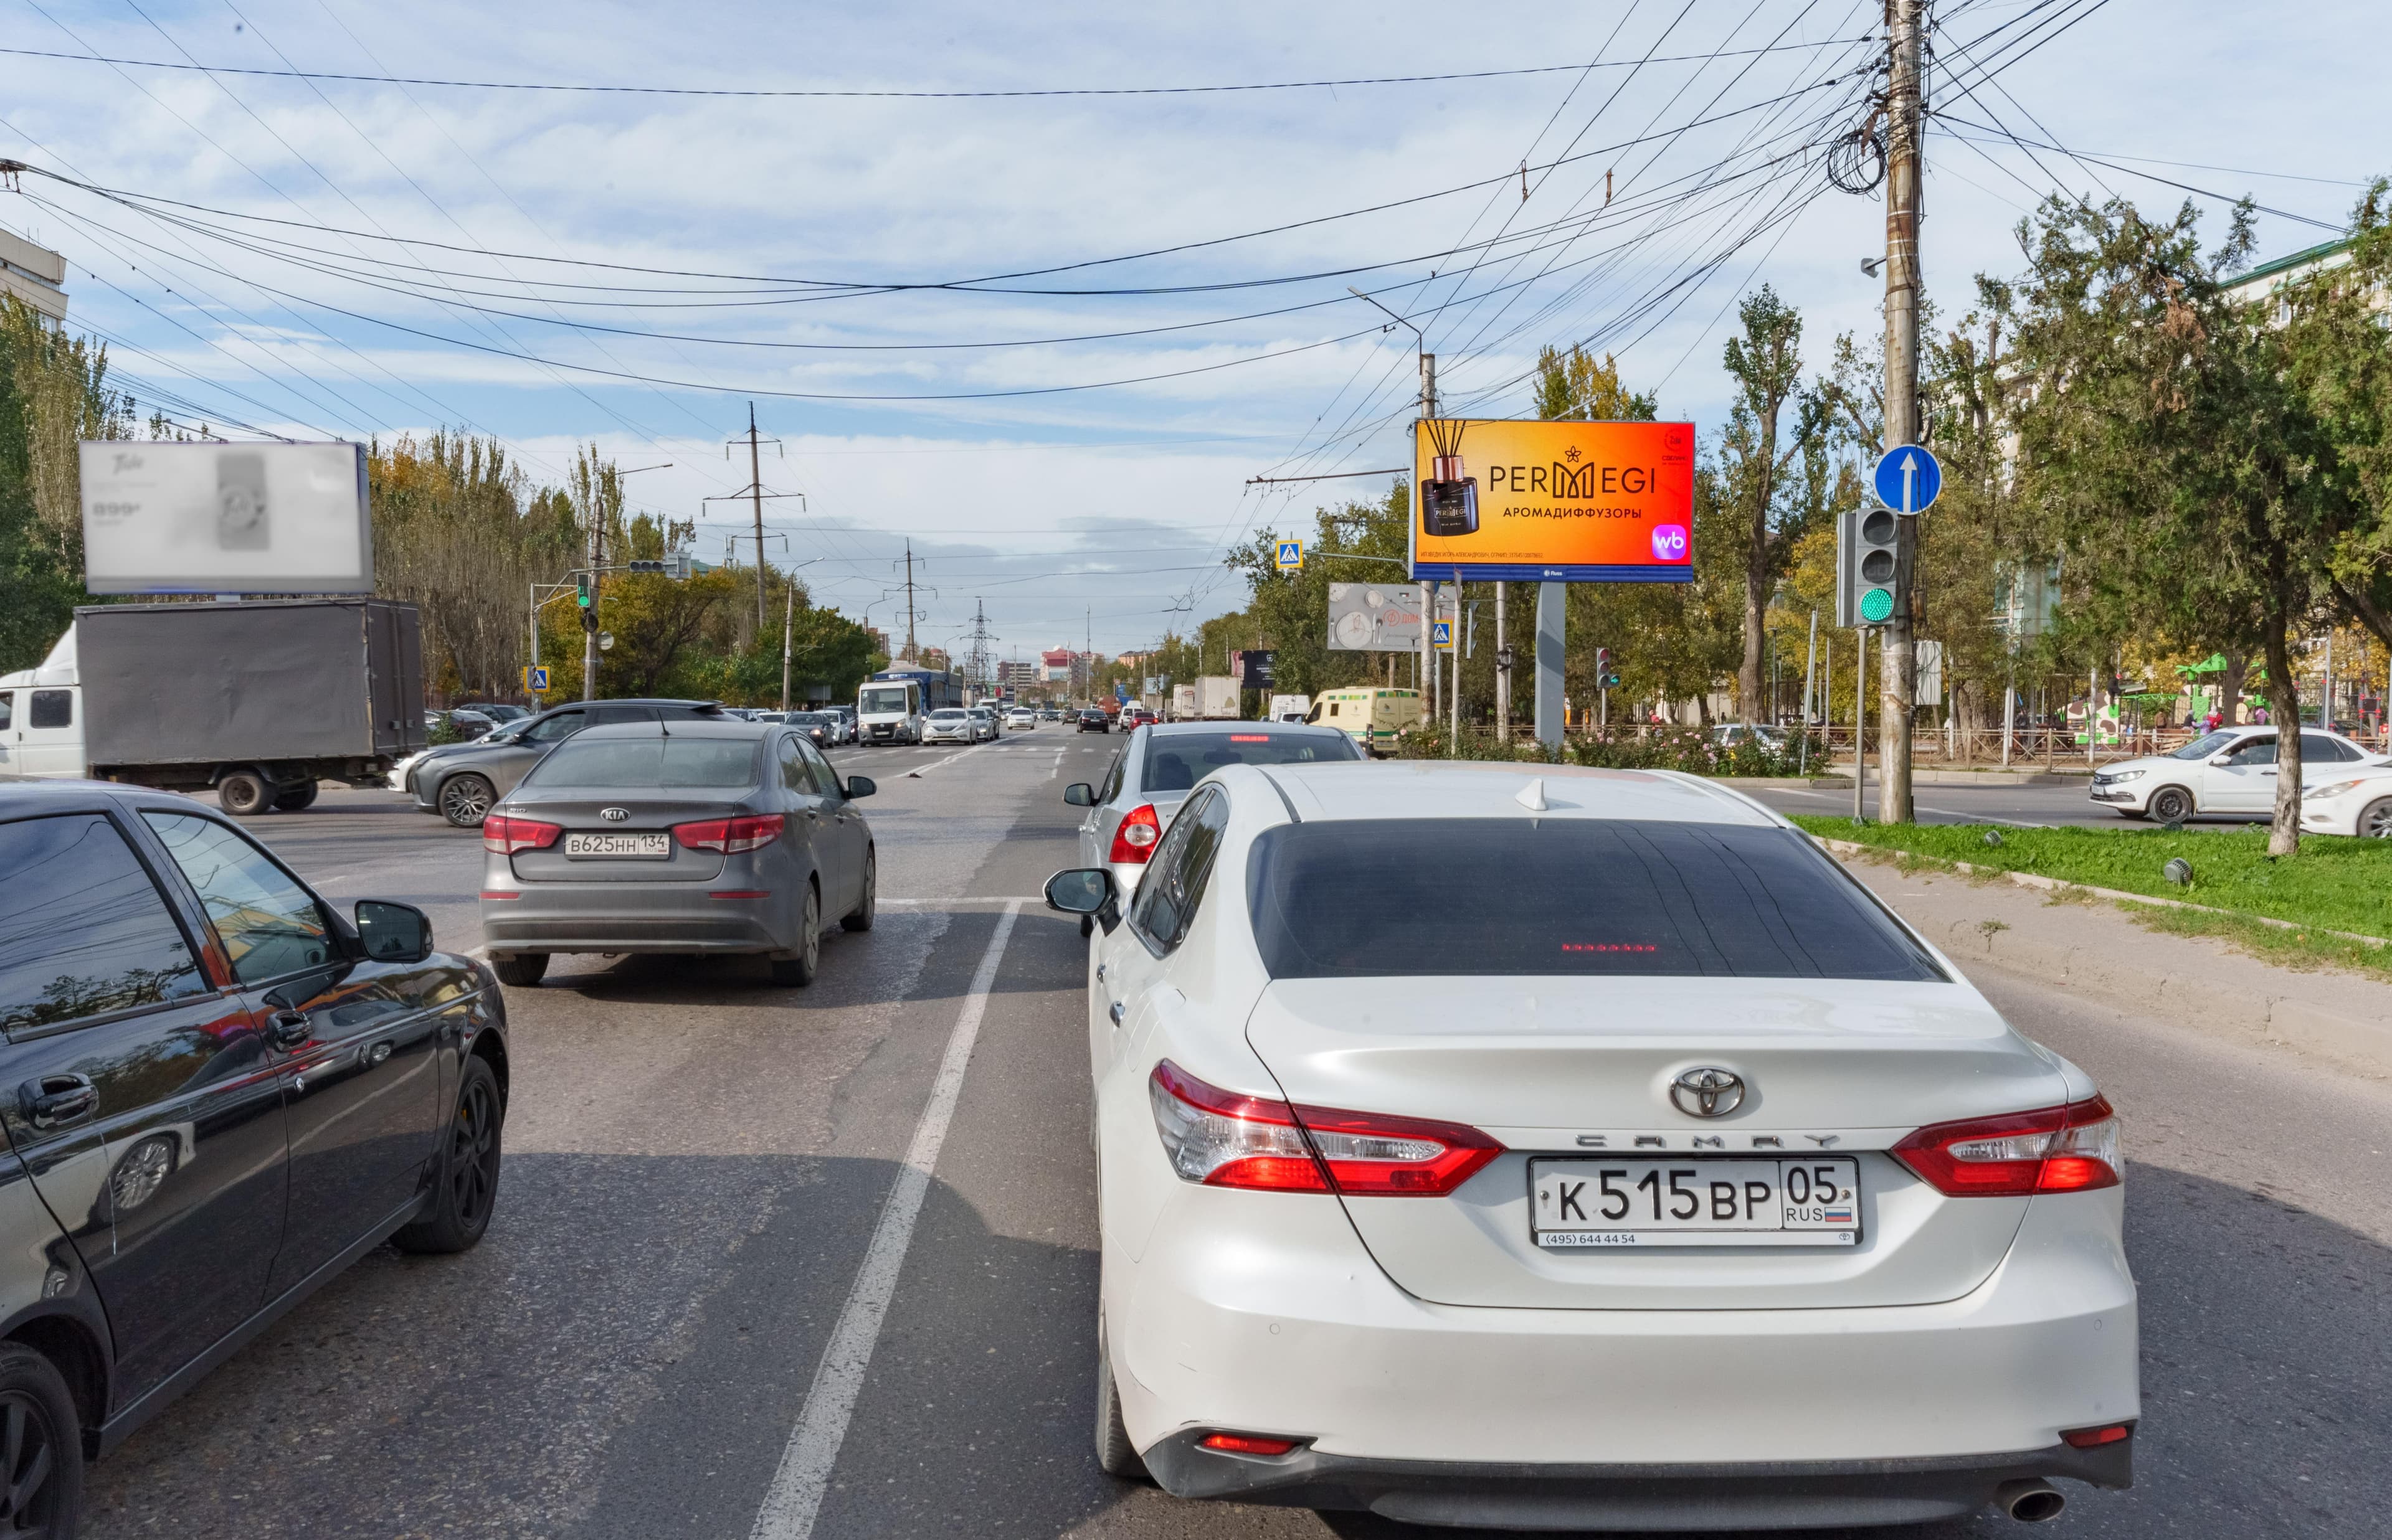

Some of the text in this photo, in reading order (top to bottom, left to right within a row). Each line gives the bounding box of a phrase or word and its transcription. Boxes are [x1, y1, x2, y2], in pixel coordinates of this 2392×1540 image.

[1490, 461, 1654, 499] PERMEGI
[1503, 508, 1641, 519] АРОМАДИФФУЗОРЫ
[1654, 531, 1684, 549] wb
[605, 811, 625, 820] KIA
[640, 835, 665, 848] 134
[1575, 1134, 1841, 1148] CAMRY
[1559, 1166, 1838, 1221] К515ВР 05
[1786, 1207, 1823, 1222] RUS
[1545, 1234, 1636, 1245] (495) 644 44 54
